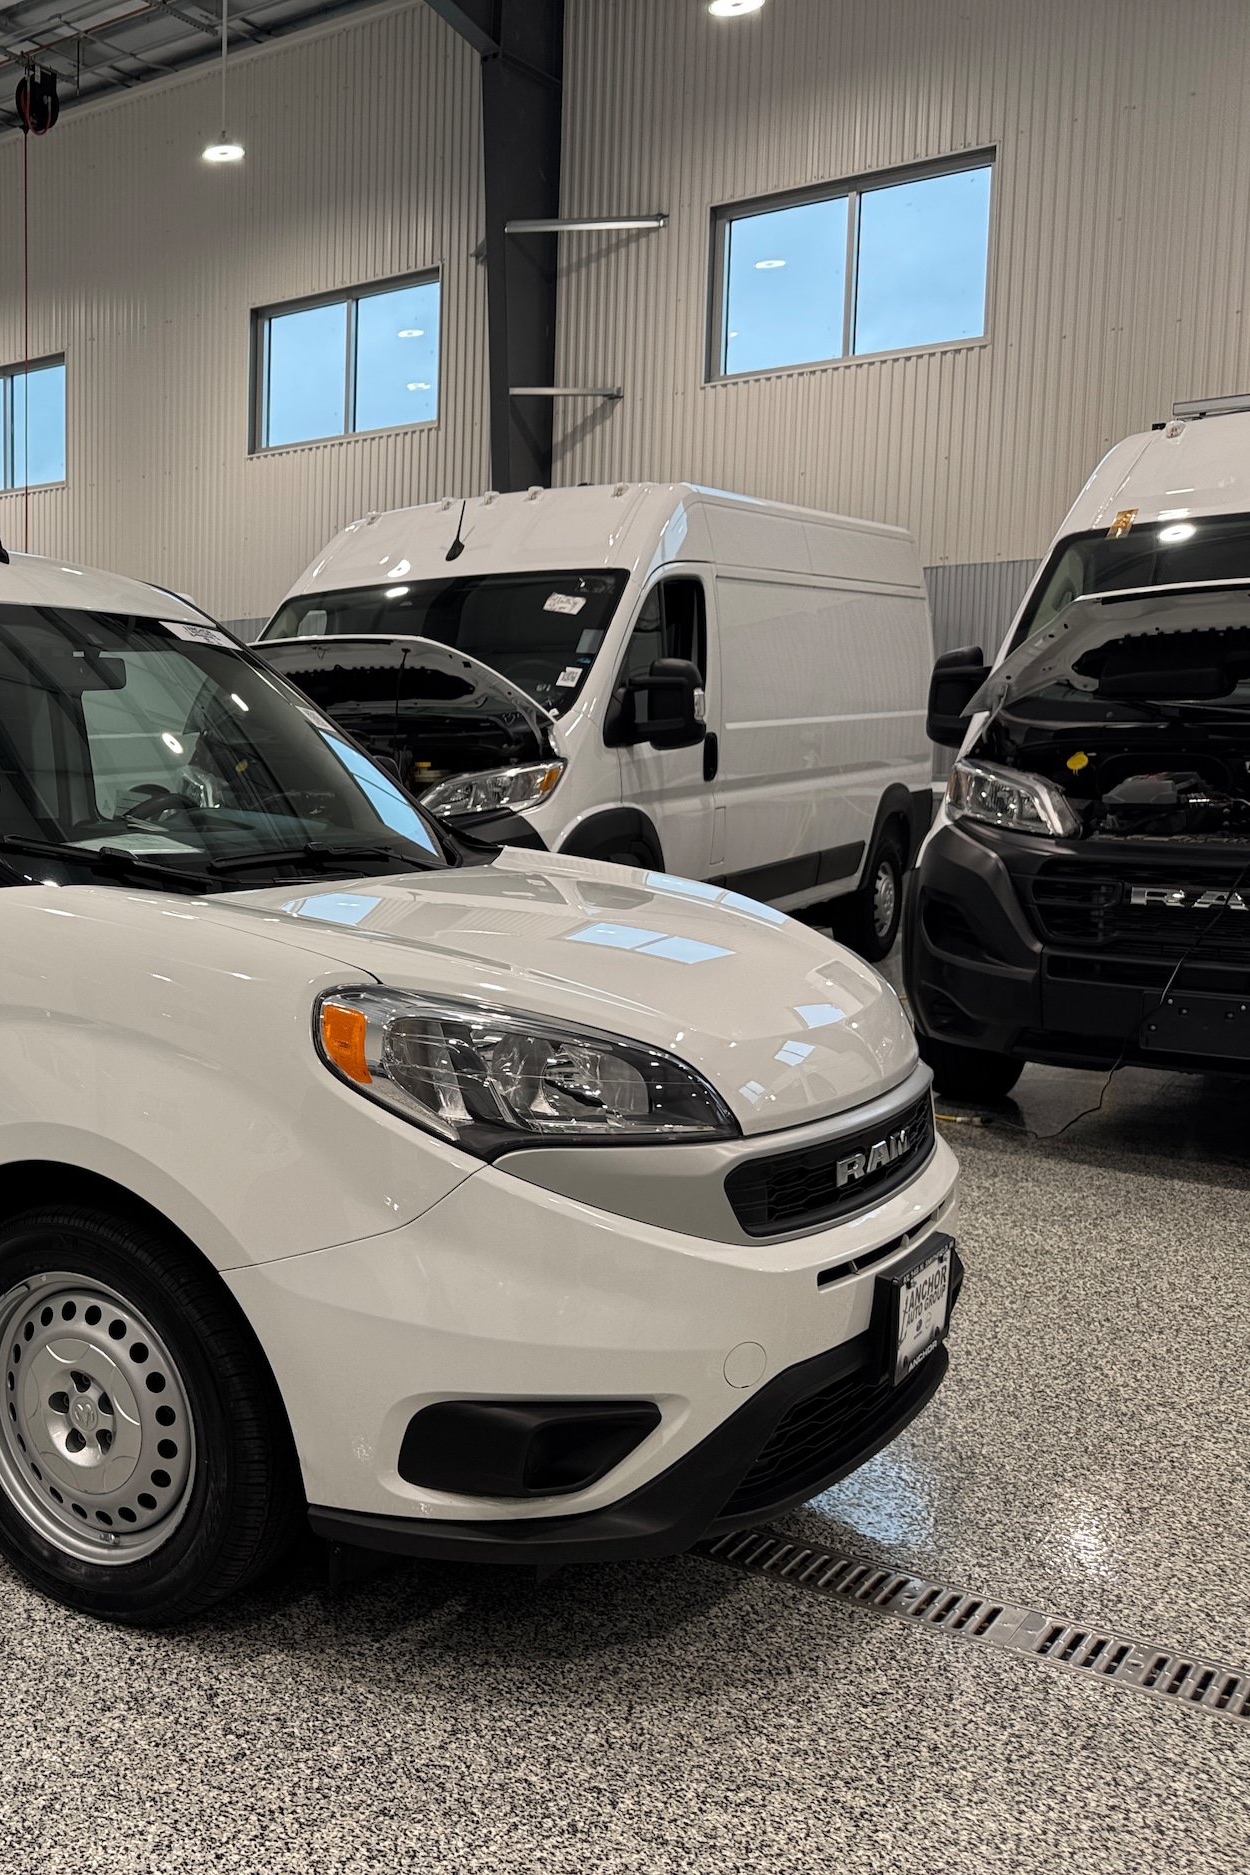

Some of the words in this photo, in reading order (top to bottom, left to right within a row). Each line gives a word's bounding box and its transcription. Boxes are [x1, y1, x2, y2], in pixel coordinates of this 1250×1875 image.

[836, 1126, 911, 1188] RAM
[906, 1304, 923, 1328] AUTO
[923, 1284, 946, 1312] GROUP
[907, 1264, 947, 1310] ANCHOR
[908, 1340, 938, 1373] ANCHOR
